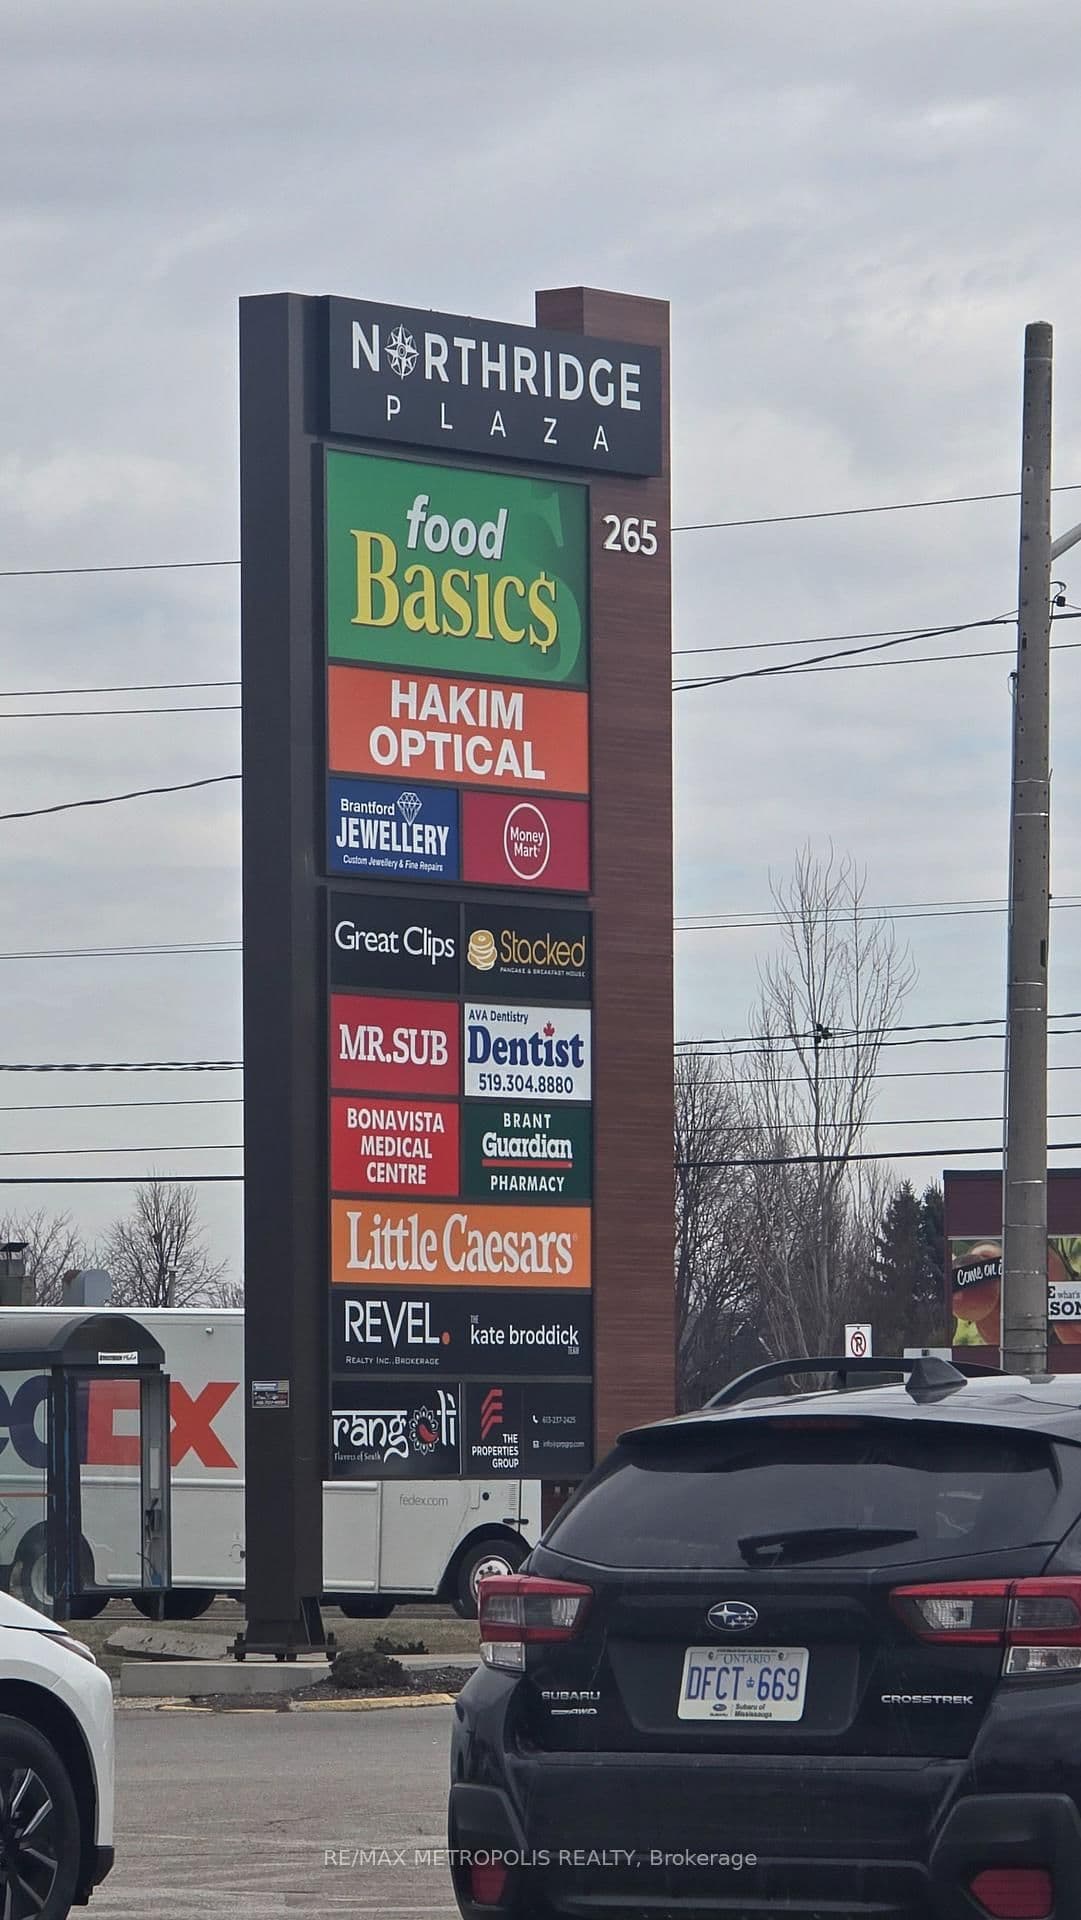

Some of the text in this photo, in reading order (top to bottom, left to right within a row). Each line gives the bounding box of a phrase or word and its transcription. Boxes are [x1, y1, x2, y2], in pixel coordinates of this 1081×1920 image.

[387, 395, 609, 452] PLAZA
[406, 494, 508, 560] food
[602, 514, 658, 556] 265
[391, 679, 524, 731] HAKIM
[369, 725, 546, 780] OPTICAL
[340, 798, 395, 816] Brantford
[336, 816, 450, 856] JEWELLERY
[510, 826, 544, 846] Money
[514, 842, 538, 857] Mart
[343, 854, 367, 866] Custom
[368, 857, 398, 870] Jewellery
[405, 860, 418, 870] Fine
[420, 861, 443, 872] Repairs
[335, 920, 455, 965] Great Clips
[500, 929, 586, 967] Stacked
[500, 966, 526, 974] PANCAKE
[533, 968, 565, 976] BREAKFAST
[469, 1009, 529, 1025] AVA Dentistry
[339, 1024, 448, 1066] MR.SUB
[467, 1025, 584, 1069] Dentist
[479, 1073, 574, 1094] 519.304.8880
[347, 1108, 445, 1133] BONAVISTA
[503, 1112, 551, 1129] BRANT
[361, 1135, 433, 1159] MEDICAL
[482, 1131, 573, 1159] Guardian
[367, 1162, 426, 1184] CENTRE
[490, 1175, 565, 1192] PHARMACY
[346, 1211, 573, 1275] Little Caesars
[957, 1269, 983, 1286] Come
[983, 1263, 997, 1277] on
[471, 1324, 579, 1345] kate broddick
[503, 1434, 518, 1444] THE
[472, 1446, 519, 1456] PROPERTIES
[492, 1458, 519, 1468] GROUP
[400, 1494, 448, 1507] fedex.com
[724, 1653, 771, 1665] ONTARIO
[687, 1666, 800, 1701] DFCT 669
[541, 1691, 601, 1700] SUBARU
[881, 1695, 974, 1704] CROSSTREK
